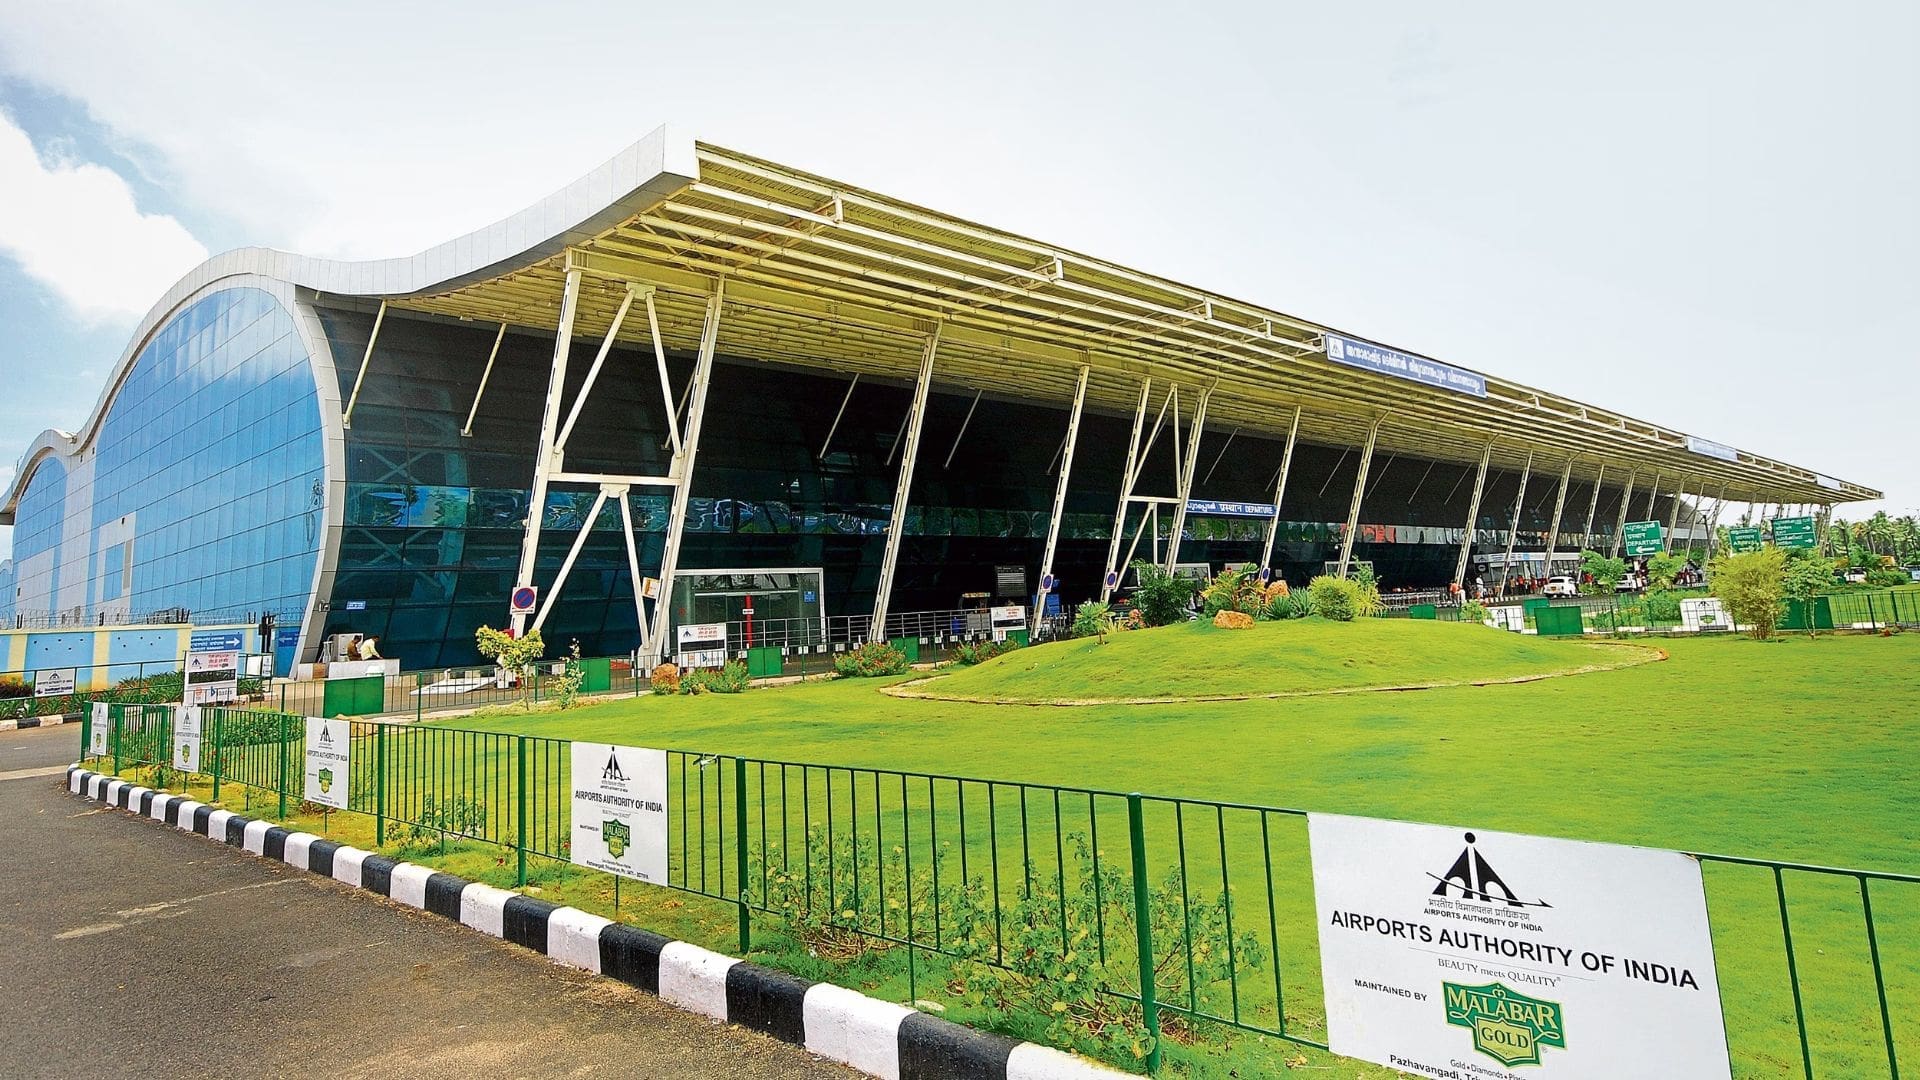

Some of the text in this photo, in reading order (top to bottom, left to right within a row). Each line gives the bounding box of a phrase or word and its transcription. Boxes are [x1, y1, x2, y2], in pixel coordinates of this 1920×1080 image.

[1245, 505, 1273, 514] DEPARTURE
[1627, 539, 1661, 547] DEPARTURE
[575, 790, 663, 813] AIRPORTS AUTHORITY OF INDIA
[1424, 908, 1543, 932] AIRPORTS AUTHORITY OF INDIA
[1428, 898, 1530, 920] भारतीय विमानपतन प्राधिकरण
[1331, 910, 1700, 990] AIRPORTS AUTHORITY OF INDIA
[1438, 958, 1478, 974] BEAUTY
[1481, 967, 1506, 978] meets
[1354, 979, 1427, 1001] MAINTAINED BY
[1447, 985, 1558, 1030] MALABAR
[1481, 1027, 1529, 1049] GOLD
